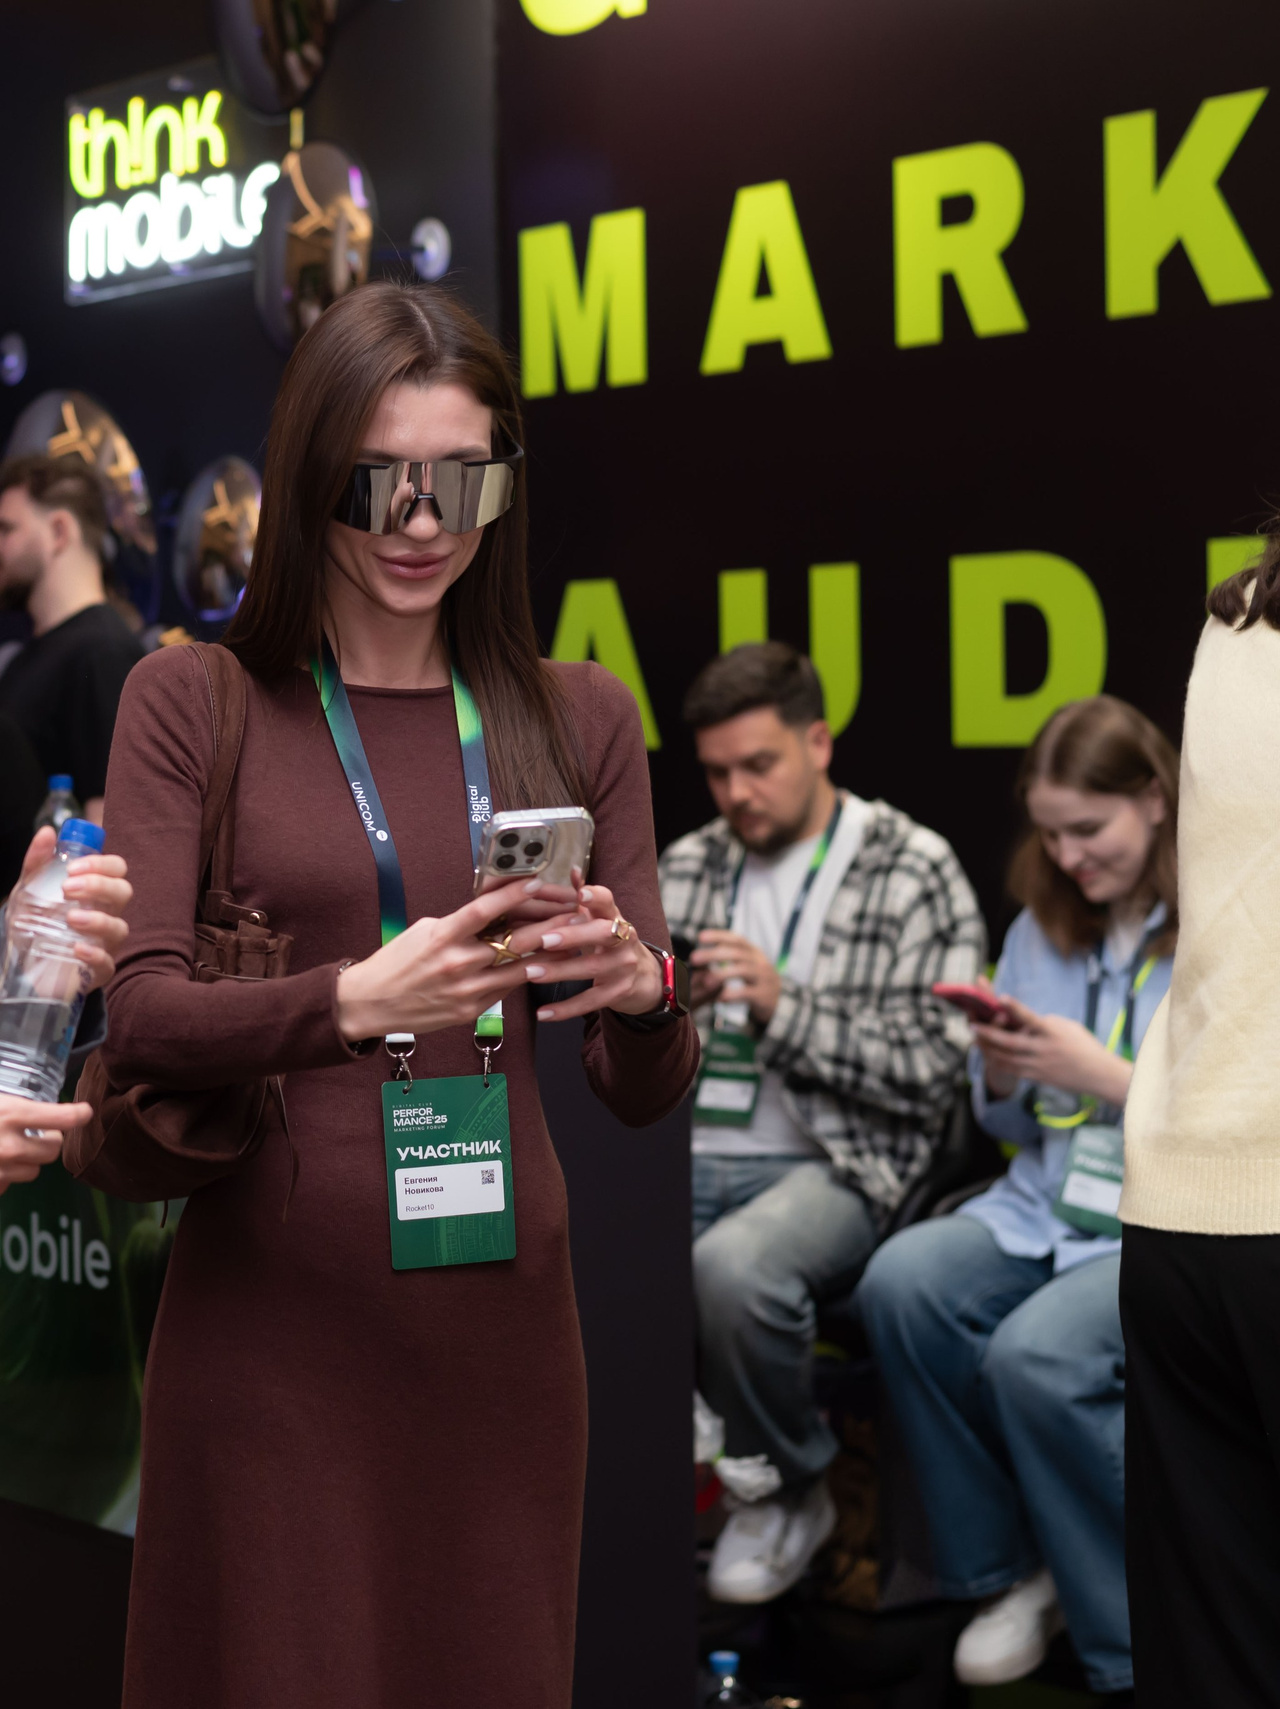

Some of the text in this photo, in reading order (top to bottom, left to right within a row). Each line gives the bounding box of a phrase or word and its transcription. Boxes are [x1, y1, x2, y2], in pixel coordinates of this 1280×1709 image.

[69, 162, 280, 282] mobile
[517, 86, 1273, 400] MARK
[351, 781, 377, 832] UNICOM
[469, 785, 482, 823] Digital
[480, 796, 491, 822] Club
[393, 1107, 433, 1118] PERFOR
[396, 1139, 502, 1162] УЧАСТНИК
[404, 1176, 438, 1185] Евгения
[405, 1186, 444, 1195] Новикова
[405, 1204, 435, 1212] Rocket10
